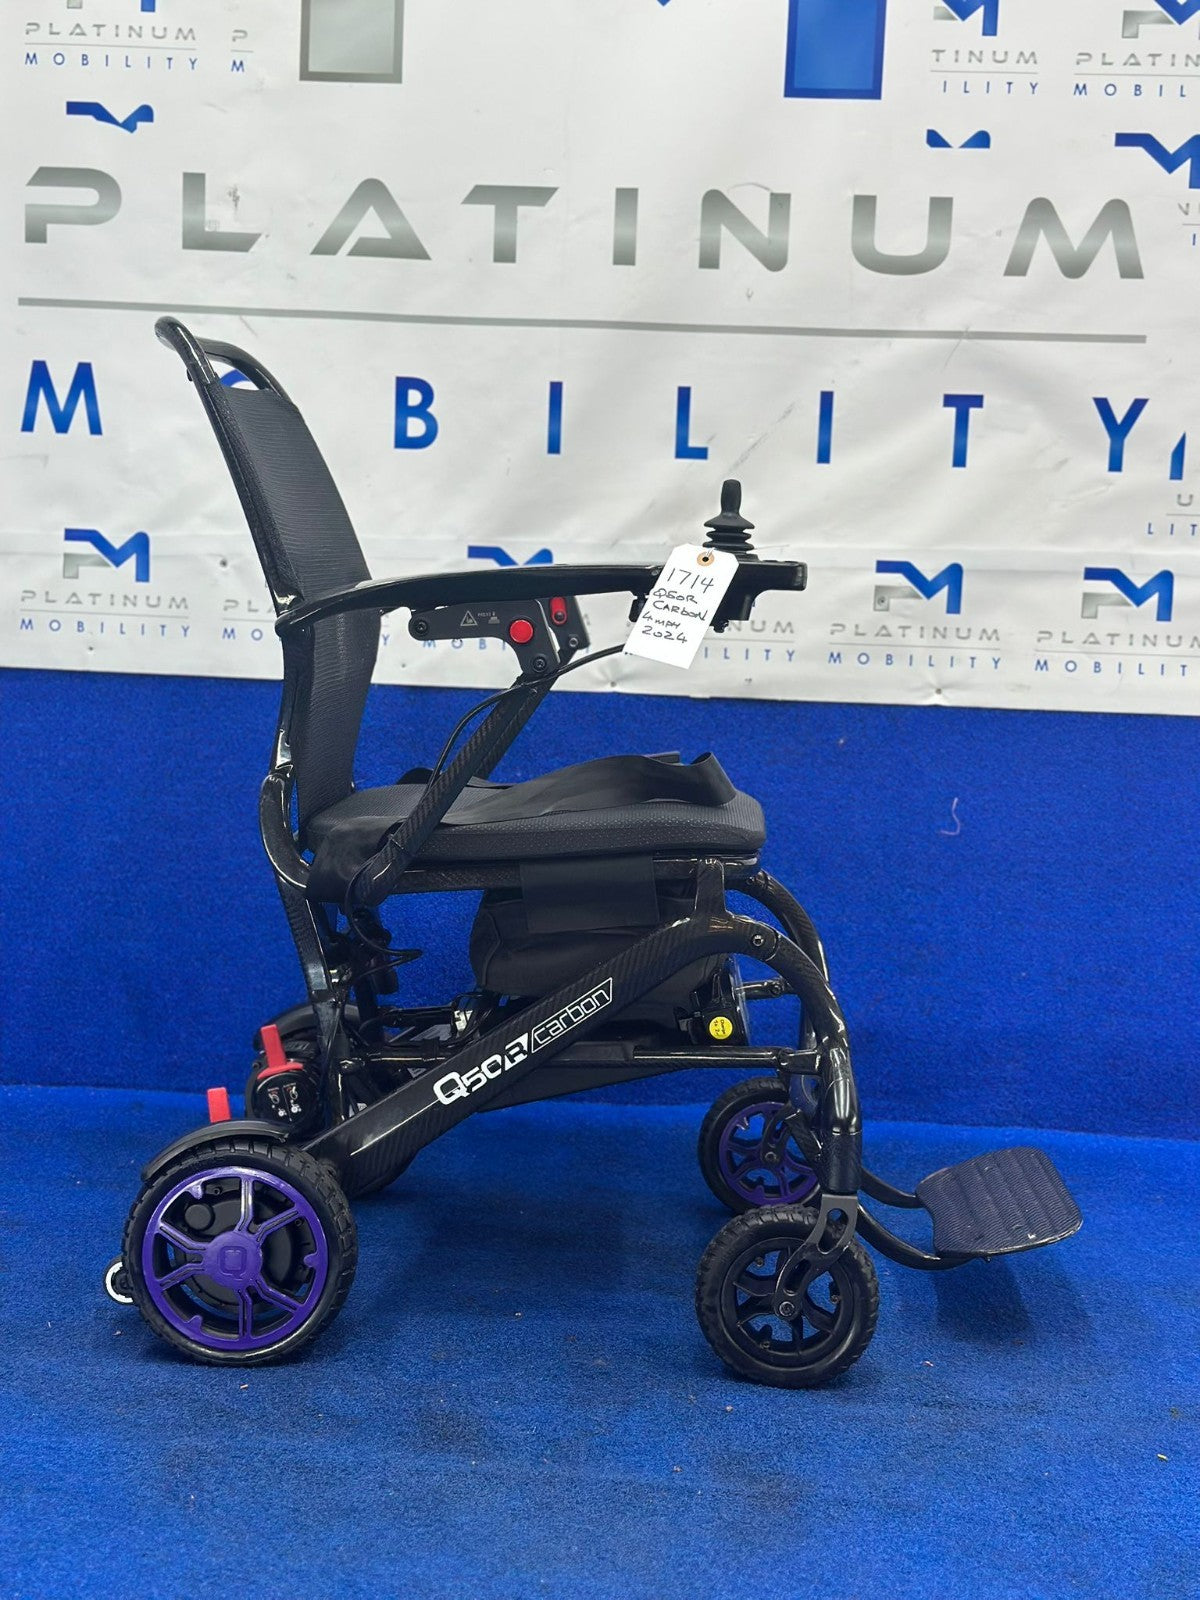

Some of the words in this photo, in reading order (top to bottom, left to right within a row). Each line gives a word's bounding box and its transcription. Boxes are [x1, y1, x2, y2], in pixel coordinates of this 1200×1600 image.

[25, 22, 197, 42] PLATINUM
[24, 52, 198, 70] MOBILITY
[24, 165, 1145, 280] PLATINUM
[20, 359, 1150, 474] MBILITY
[666, 567, 715, 594] 1714
[20, 590, 190, 611] PLATINUM
[19, 617, 191, 638] MOBILITY
[641, 625, 688, 644] 2024
[829, 622, 1001, 642] PLATINUM
[827, 652, 1001, 670] MOBILITY
[433, 1032, 530, 1105] Q50R
[533, 988, 611, 1046] carbon
